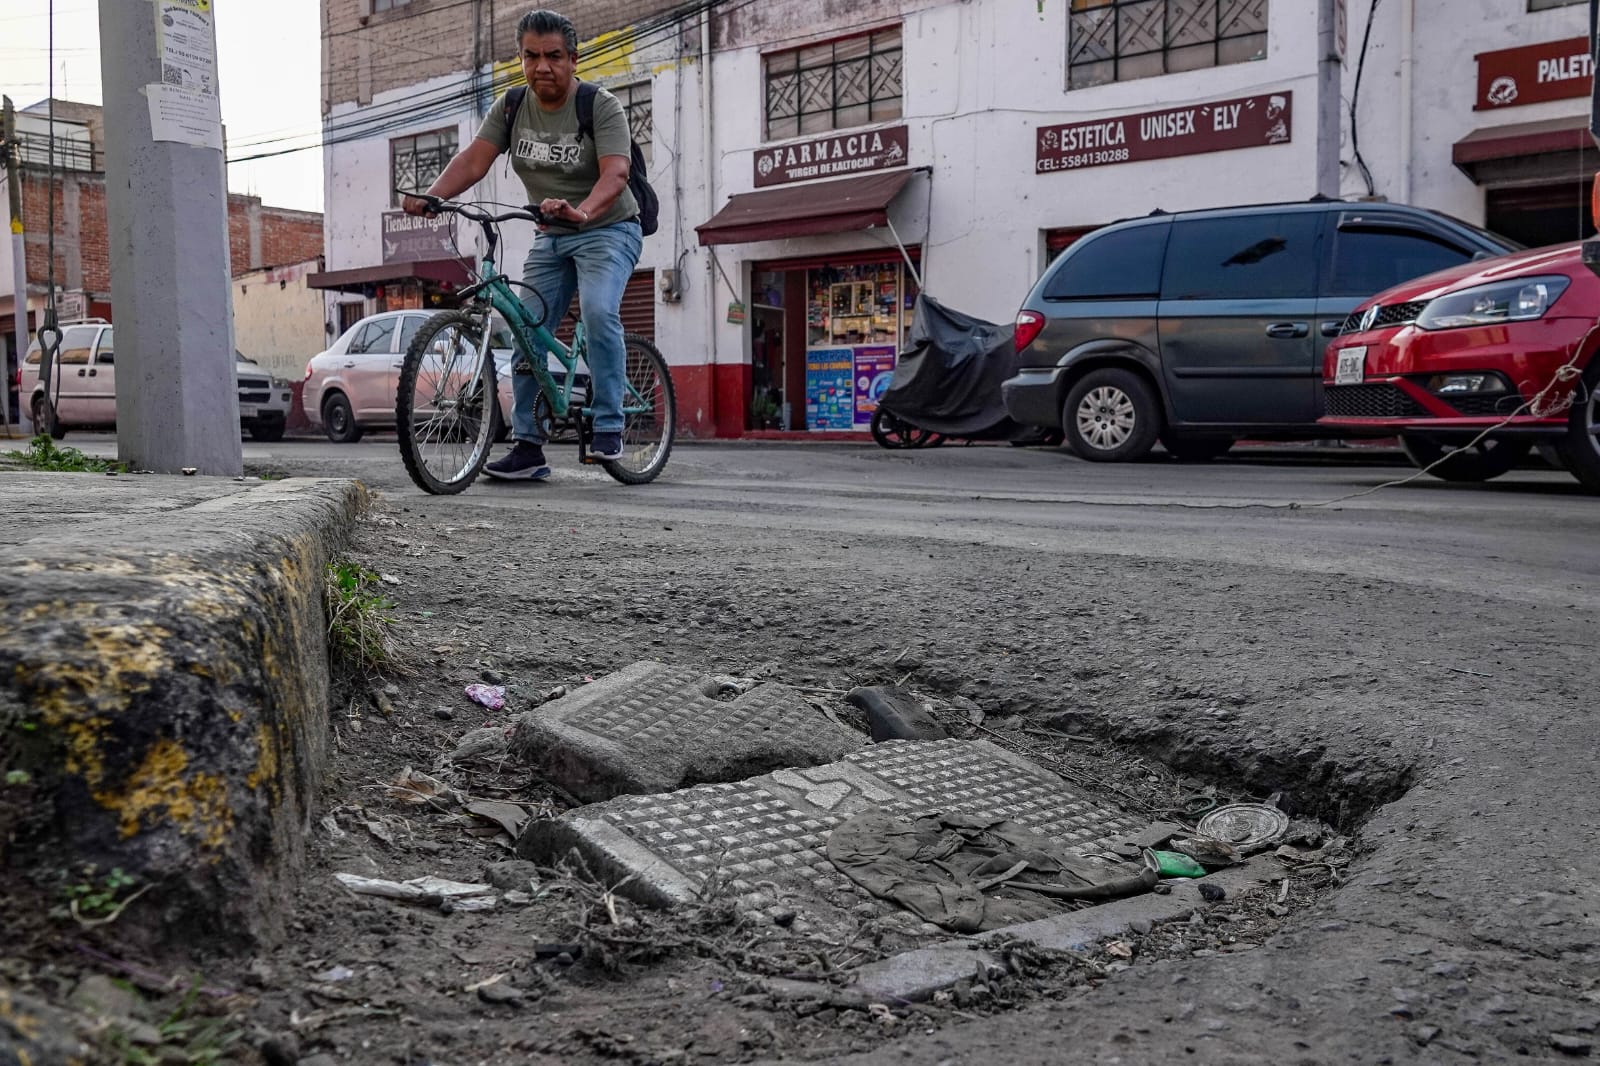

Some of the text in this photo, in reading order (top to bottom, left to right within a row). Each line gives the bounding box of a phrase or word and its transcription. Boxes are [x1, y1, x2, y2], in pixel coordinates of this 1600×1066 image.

[1537, 53, 1596, 83] PALET
[1061, 121, 1125, 151] ESTETICA
[1140, 110, 1195, 141] UNISEX
[773, 132, 883, 168] FARMACIA
[1036, 149, 1129, 171] CEL: 5584130288
[820, 164, 831, 173] DE
[384, 213, 412, 233] Tienda
[413, 216, 423, 229] de
